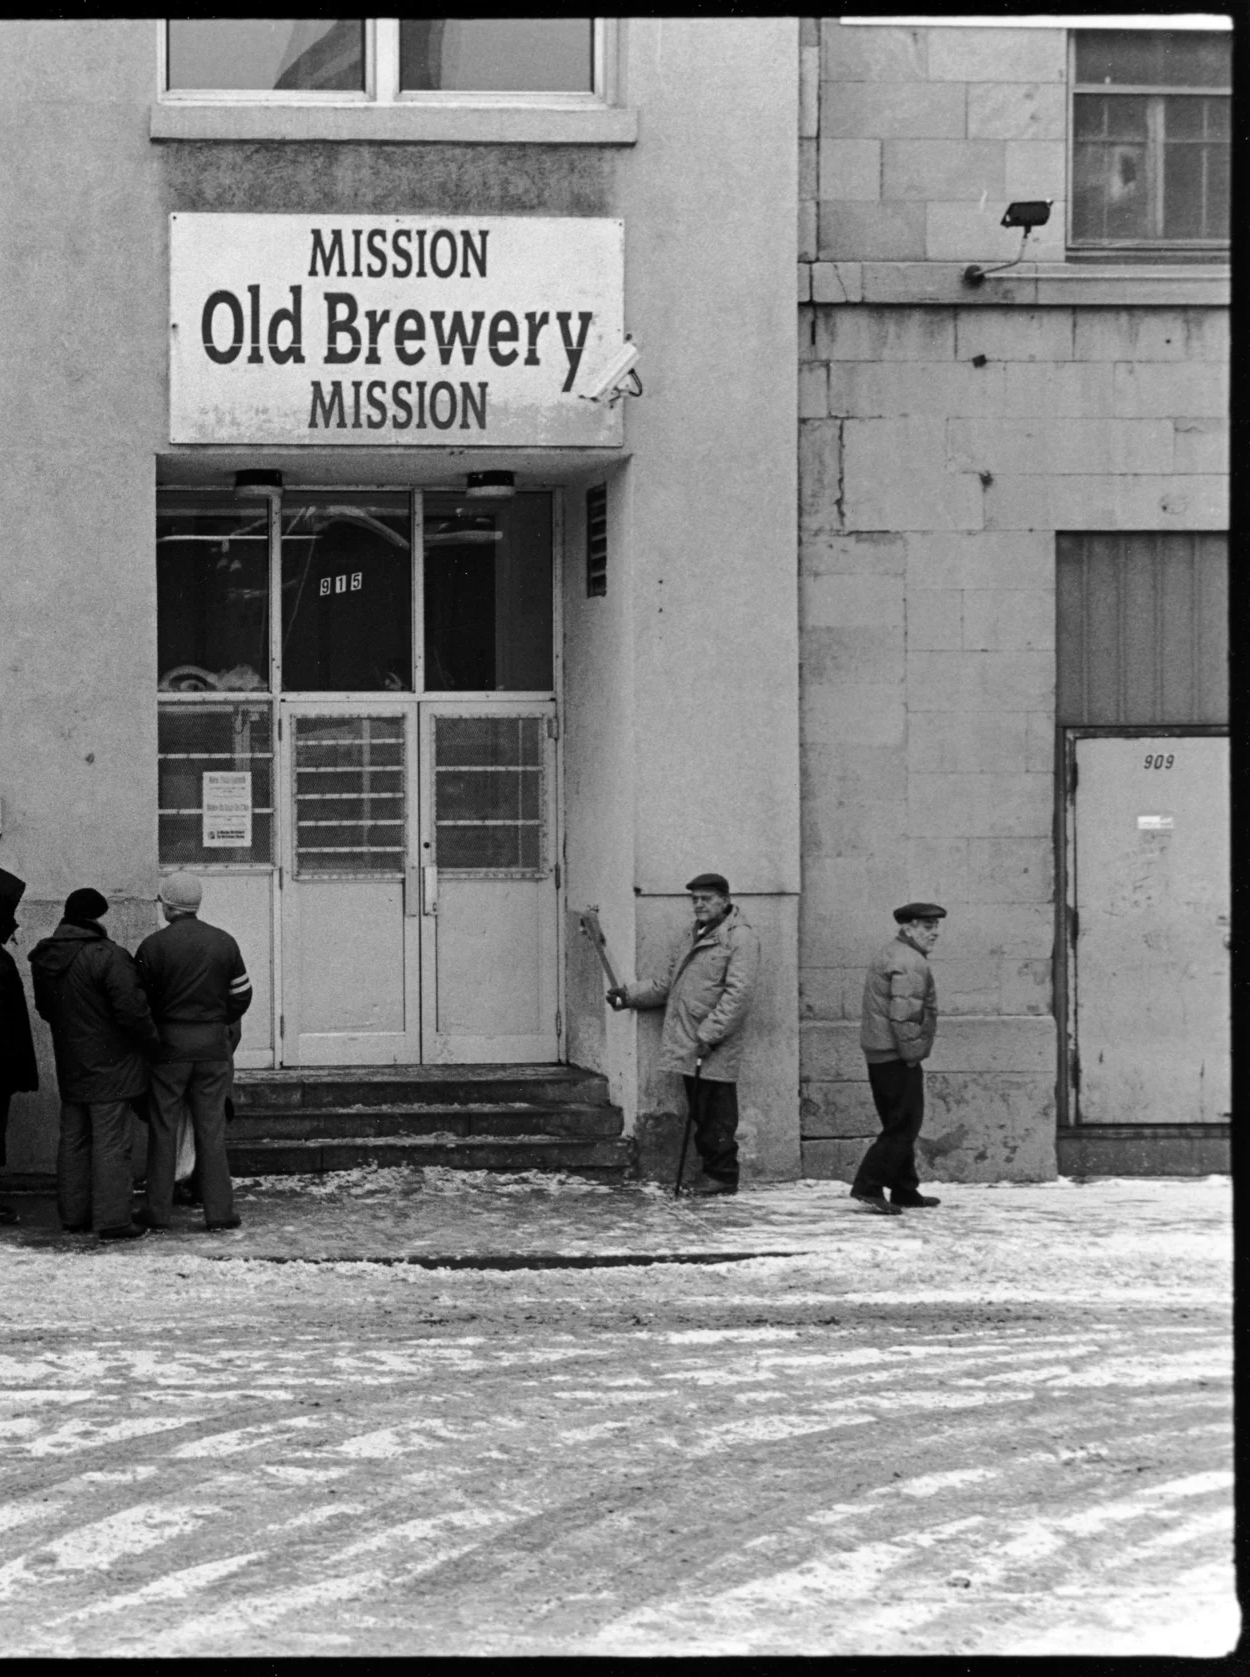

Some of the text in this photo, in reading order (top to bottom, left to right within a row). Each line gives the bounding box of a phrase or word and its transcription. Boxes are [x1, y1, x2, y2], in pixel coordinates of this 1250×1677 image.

[308, 228, 490, 278] MISSION
[201, 284, 593, 393] Old Brewery
[307, 380, 489, 430] MISSION
[320, 572, 362, 596] 915
[1143, 754, 1175, 770] 909
